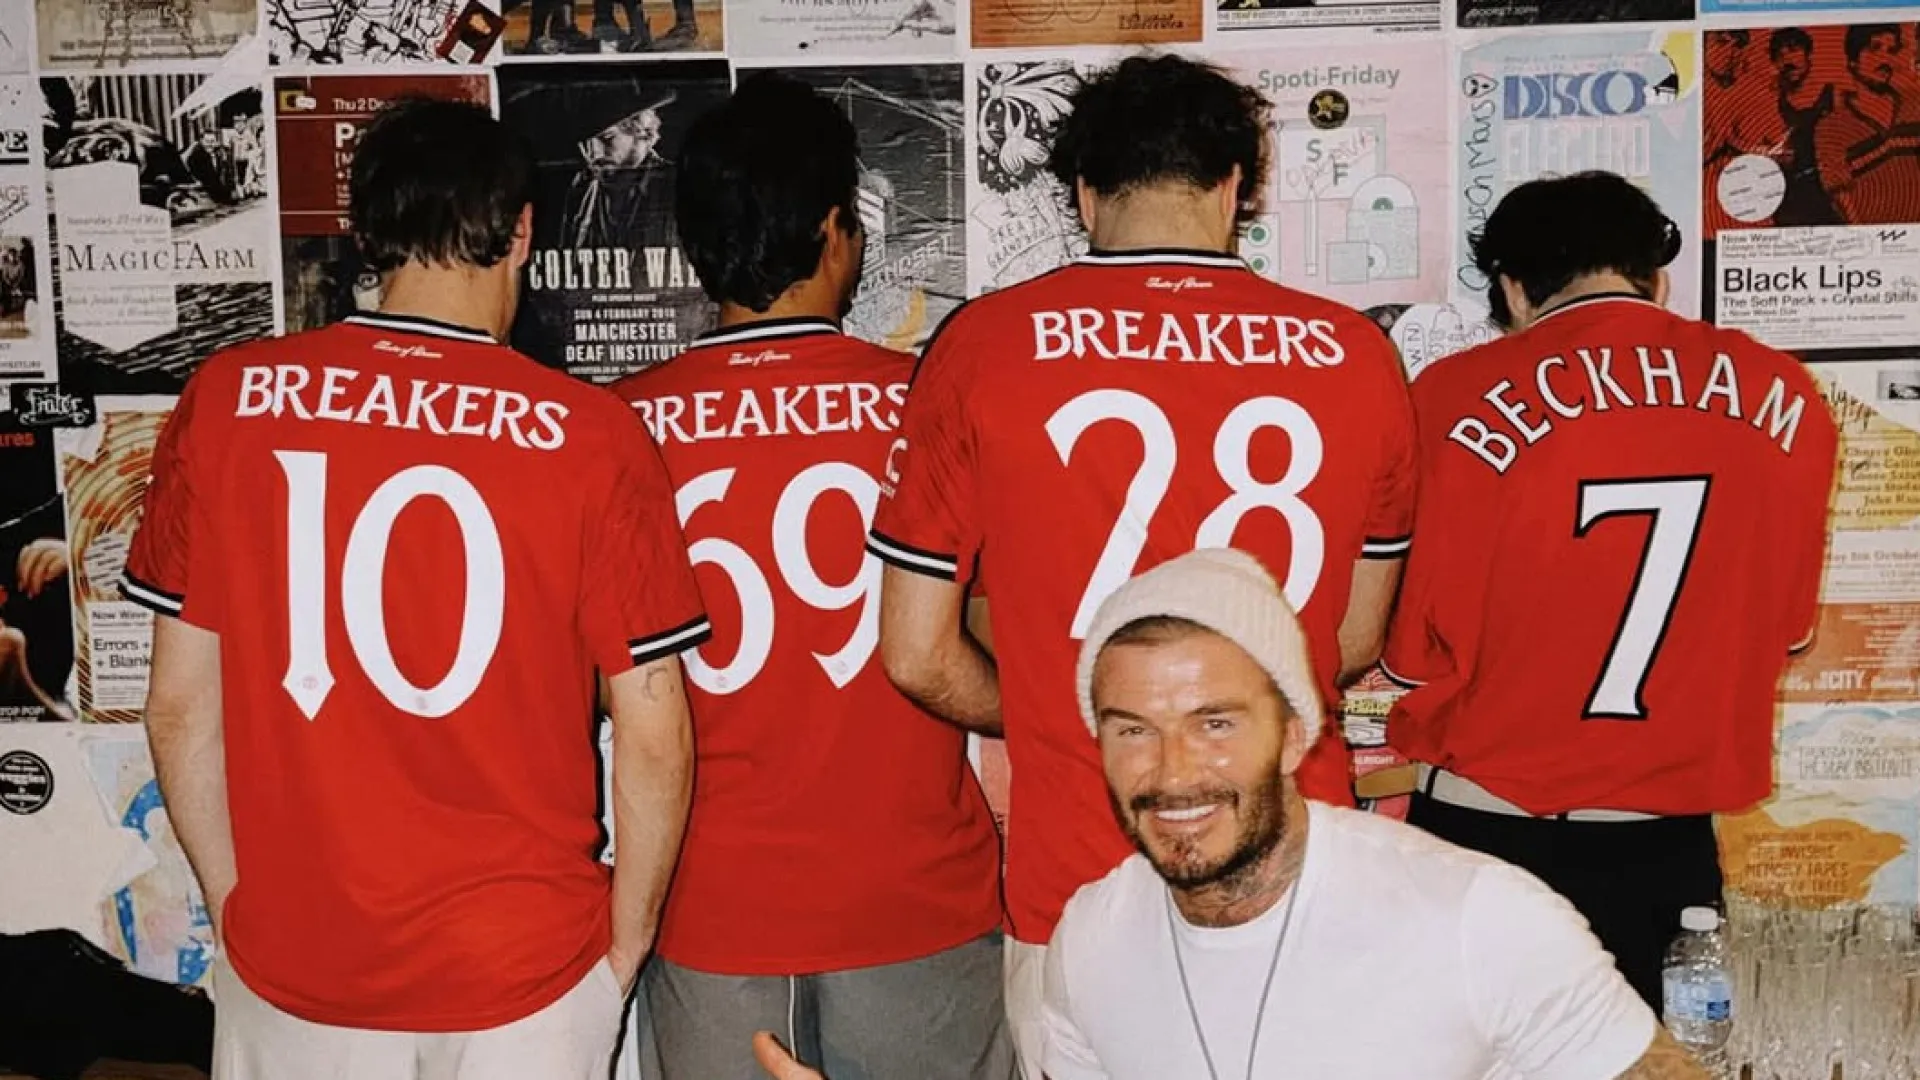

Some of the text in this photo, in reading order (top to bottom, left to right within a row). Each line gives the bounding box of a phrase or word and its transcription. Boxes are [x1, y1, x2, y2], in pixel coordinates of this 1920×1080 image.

[1257, 64, 1400, 93] Spoti-Friday
[1503, 69, 1648, 120] DISCO
[332, 97, 356, 111] Thu
[357, 97, 366, 111] 2
[529, 247, 632, 290] COLTER
[1723, 264, 1882, 294] Black Lips
[1722, 296, 1747, 308] The
[1750, 294, 1778, 307] Soft
[1782, 294, 1816, 306] Pack
[565, 344, 687, 362] DEAF INSTITUTE
[574, 321, 676, 342] MANCHESTER
[1030, 306, 1345, 368] BREAKERS
[235, 364, 570, 451] BREAKERS
[1445, 345, 1807, 474] BECKHAM
[1043, 388, 1325, 640] 28
[271, 449, 506, 722] 10
[675, 461, 884, 695] 69
[1573, 474, 1713, 721] 7
[93, 638, 139, 651] Errors
